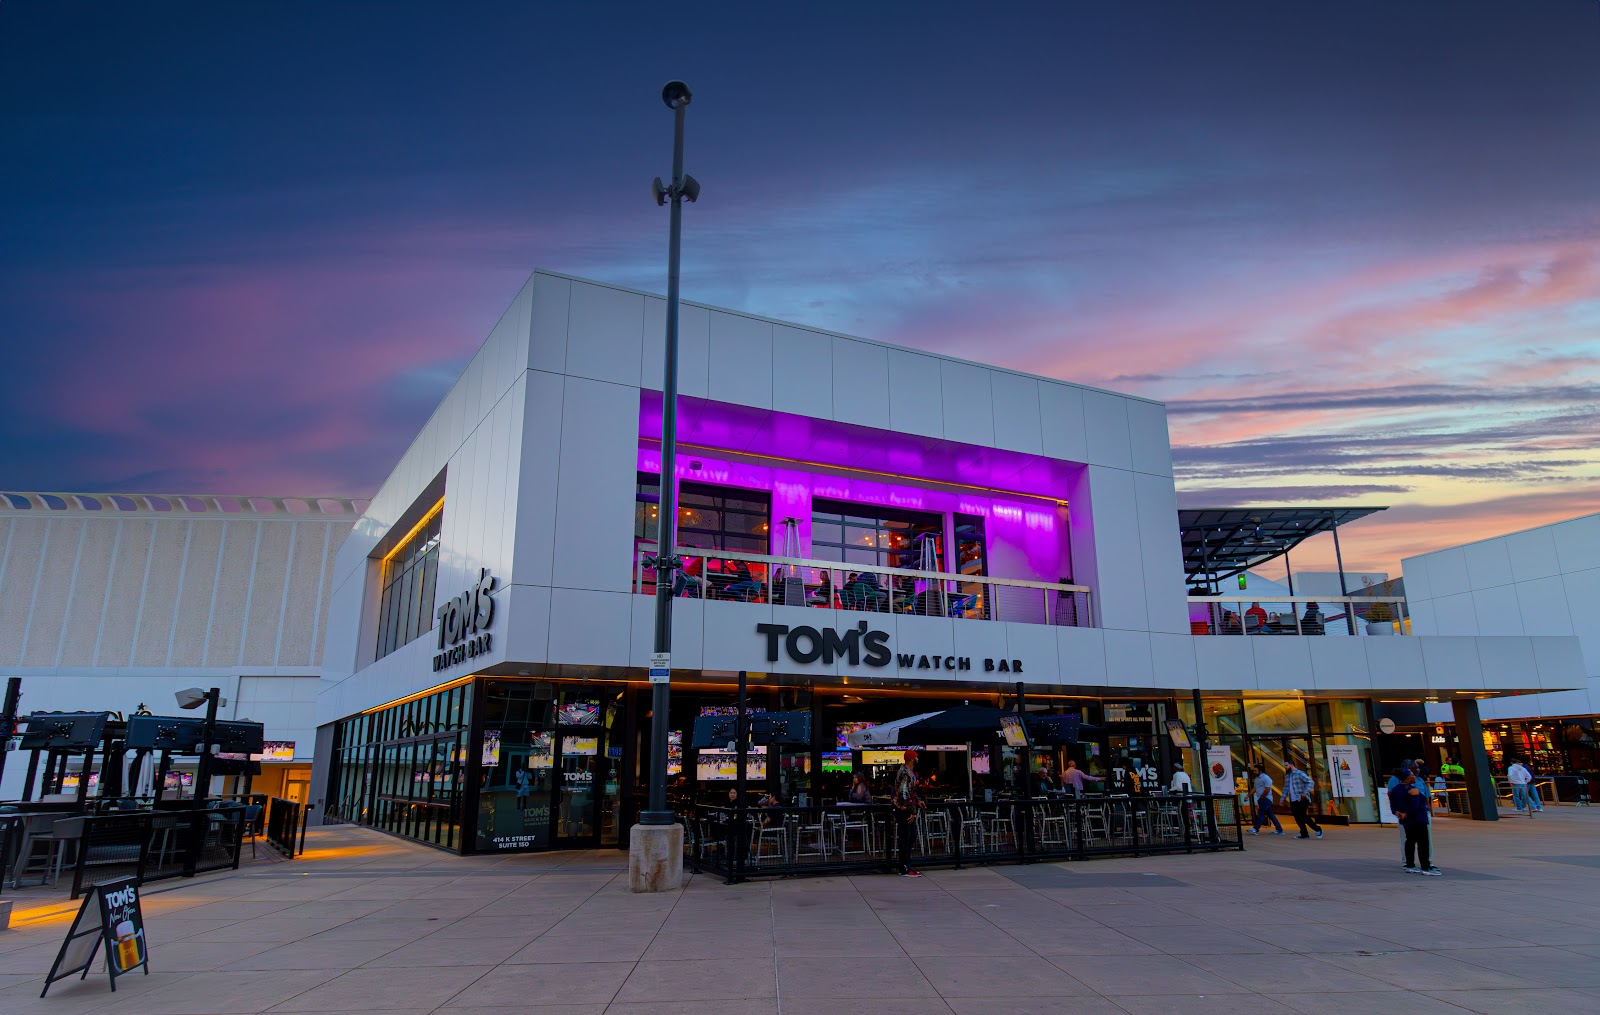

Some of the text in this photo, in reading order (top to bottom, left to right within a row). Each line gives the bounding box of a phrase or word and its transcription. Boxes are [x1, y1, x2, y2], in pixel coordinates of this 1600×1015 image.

[437, 568, 494, 650] TOM'S
[433, 633, 493, 672] WATCH BAR
[757, 621, 1024, 673] TOM'S WATCH BAR
[563, 770, 592, 780] TOM'S
[524, 805, 550, 817] TOM'S
[105, 885, 136, 909] TOM'S
[109, 909, 121, 928] Now
